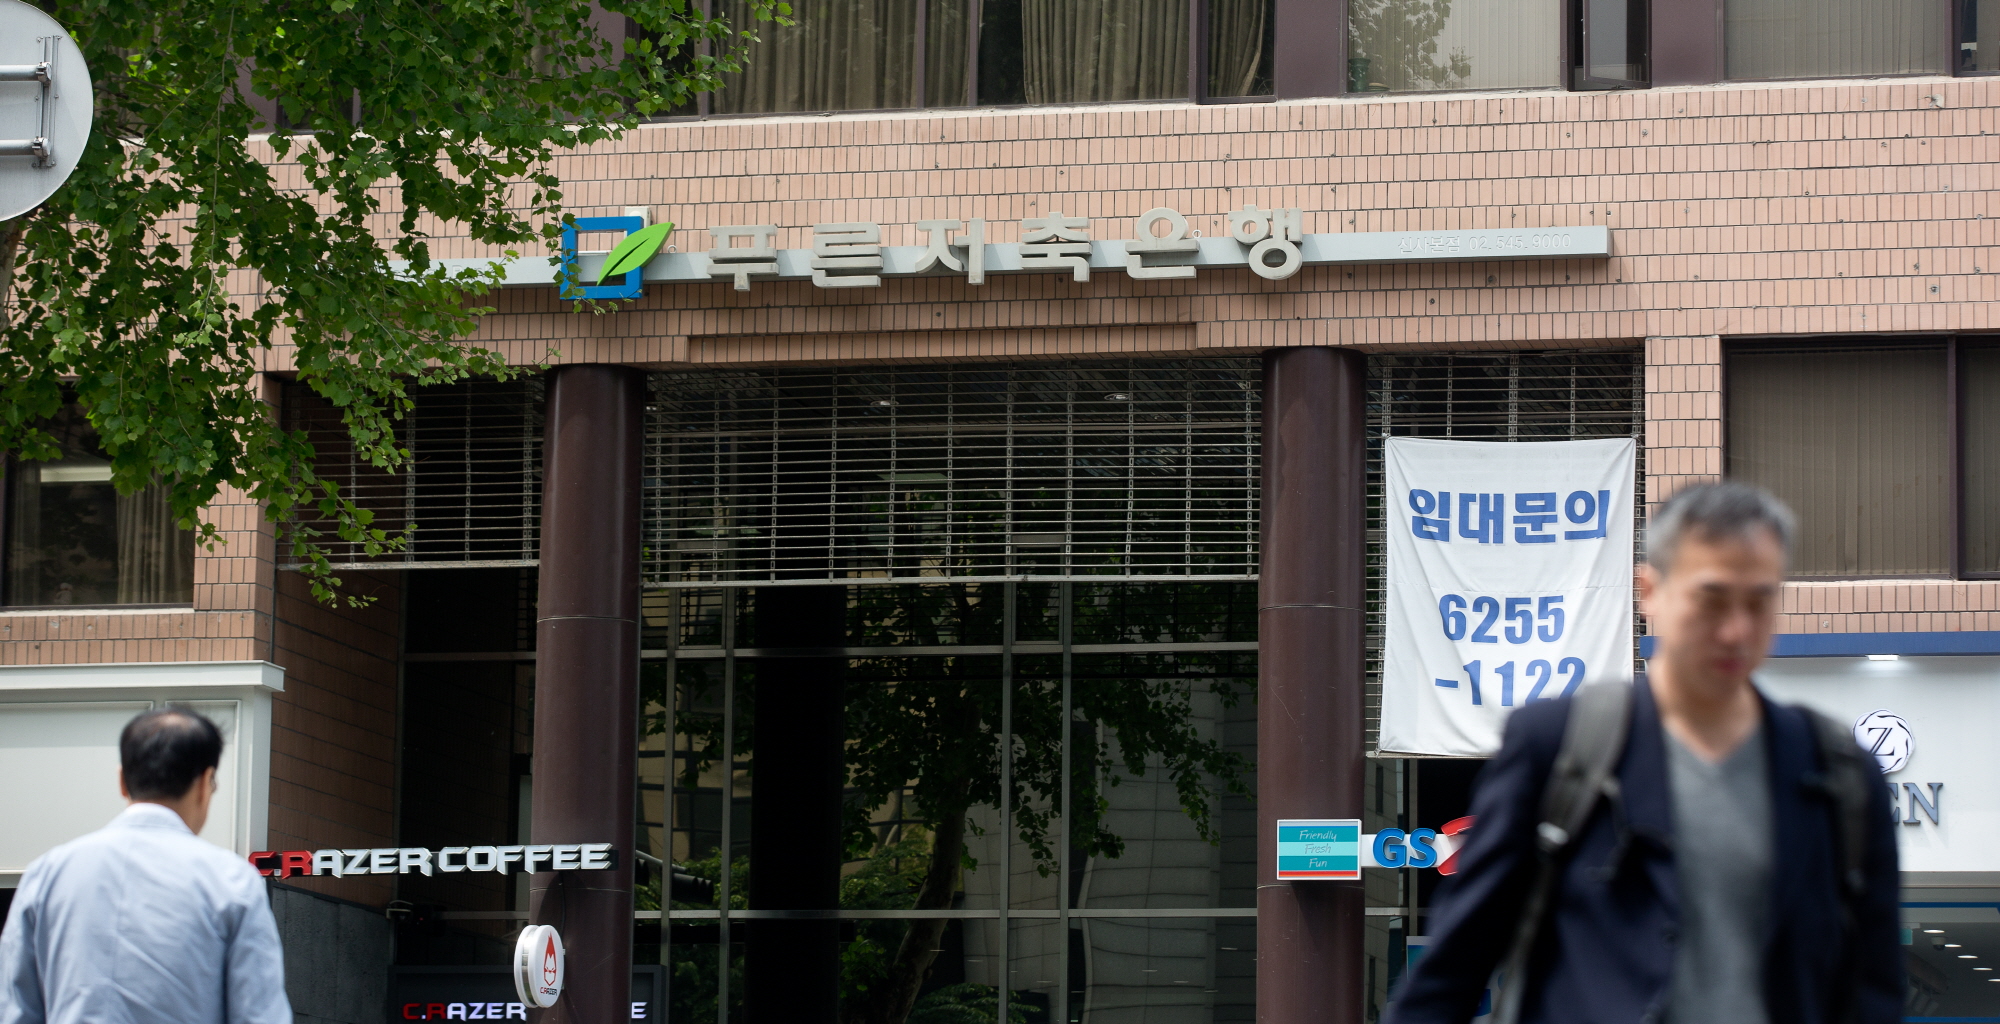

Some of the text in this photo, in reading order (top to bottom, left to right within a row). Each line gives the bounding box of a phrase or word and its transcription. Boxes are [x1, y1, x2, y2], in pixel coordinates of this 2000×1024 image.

[706, 203, 1304, 292] 푸른저축은행
[1398, 235, 1460, 253] 신사본점
[1408, 488, 1611, 544] 임대문의
[1438, 593, 1565, 645] 6255
[1435, 656, 1586, 707] -1122
[1299, 829, 1337, 843] Friendly
[1304, 843, 1332, 855] Fresh
[247, 843, 613, 880] C.RAZER COFFEE
[1308, 857, 1328, 869] Fun
[402, 1001, 527, 1022] C.RAZER
